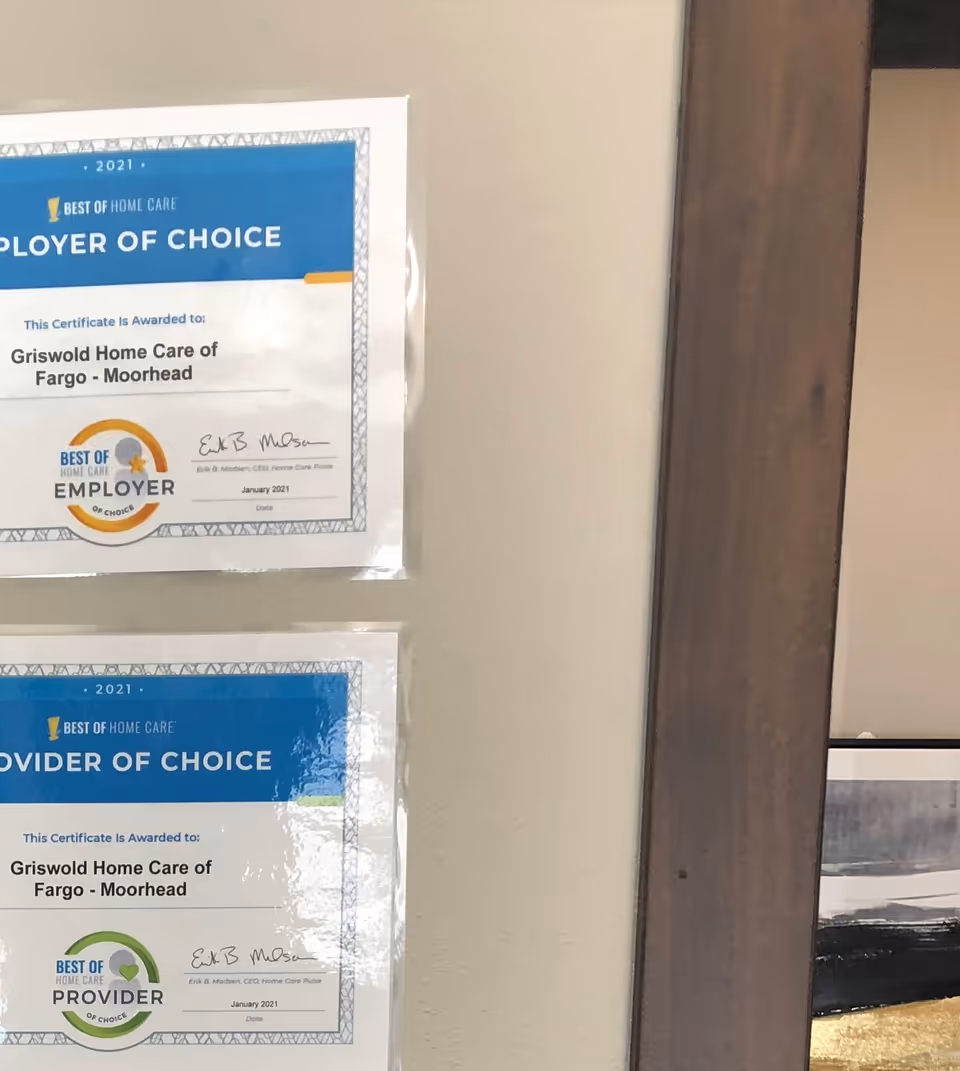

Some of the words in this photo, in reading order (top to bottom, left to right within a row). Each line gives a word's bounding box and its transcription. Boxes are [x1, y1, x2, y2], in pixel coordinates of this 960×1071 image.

[96, 159, 132, 172] 2021
[64, 201, 90, 215] BEST
[94, 200, 108, 214] OF
[110, 199, 143, 213] HOME
[147, 197, 177, 212] CARE
[117, 230, 157, 252] OF
[167, 225, 281, 249] CHOICE
[24, 320, 48, 330] This
[52, 317, 115, 329] Certificate
[119, 317, 128, 326] Is
[132, 314, 186, 325] Awarded
[190, 314, 205, 324] to:
[11, 346, 90, 364] Griswold
[96, 345, 147, 361] Home
[153, 343, 194, 359] Care
[200, 341, 218, 357] of
[36, 370, 87, 388] Fargo
[104, 365, 192, 383] Moorhead
[60, 451, 90, 465] BEST
[94, 450, 109, 464] OF
[55, 480, 174, 498] EMPLOYER
[241, 486, 270, 494] January
[272, 485, 289, 493] 2021
[92, 506, 102, 514] OF
[104, 504, 134, 516] CHOICE
[95, 684, 132, 695] 2021
[64, 721, 90, 734] BEST
[93, 721, 106, 734] OF
[110, 721, 140, 734] HOME
[145, 721, 174, 734] CARE
[112, 751, 151, 772] OF
[160, 750, 272, 771] CHOICE
[23, 833, 47, 843] This
[51, 832, 112, 843] Certificate
[116, 833, 125, 842] Is
[128, 832, 181, 842] Awarded
[184, 833, 200, 842] to:
[11, 861, 87, 875] Griswold
[94, 861, 143, 875] Home
[148, 860, 188, 875] Care
[194, 860, 212, 874] of
[35, 882, 84, 900] Fargo
[101, 882, 186, 897] Moorhead
[56, 960, 85, 973] BEST
[89, 960, 104, 973] OF
[56, 976, 79, 985] HOME
[83, 975, 104, 984] CARE
[53, 990, 163, 1004] PROVIDER
[98, 1012, 127, 1023] CHOICE
